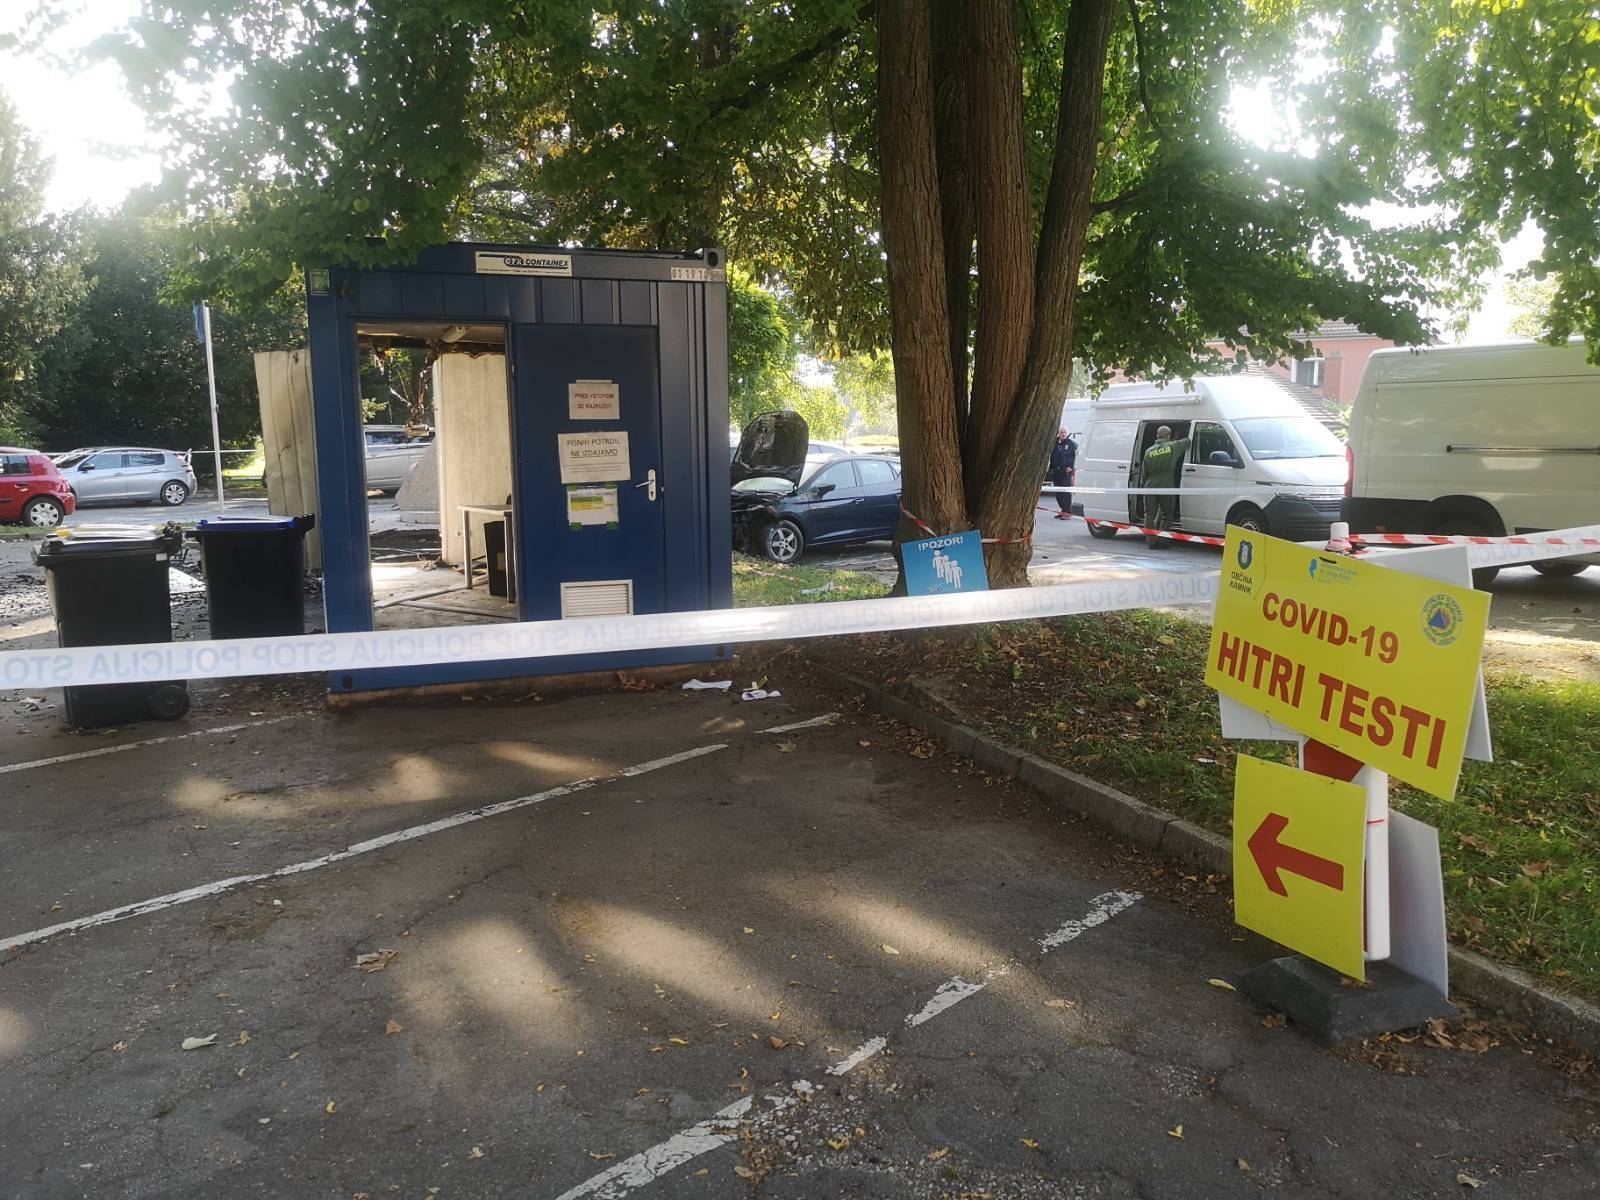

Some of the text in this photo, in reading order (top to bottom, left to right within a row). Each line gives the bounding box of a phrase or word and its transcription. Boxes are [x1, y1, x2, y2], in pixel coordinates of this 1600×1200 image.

[525, 258, 569, 268] CONTAINEX
[566, 438, 621, 447] PISNIH POTRDIL
[582, 449, 618, 457] IZDAJAMO
[1149, 446, 1172, 458] POLICIJA
[1231, 570, 1253, 585] OBČINA
[1229, 580, 1252, 594] KAMNIK
[1262, 591, 1400, 665] COVID-19
[1217, 631, 1306, 709] HITRI
[1318, 672, 1447, 770] TESTI
